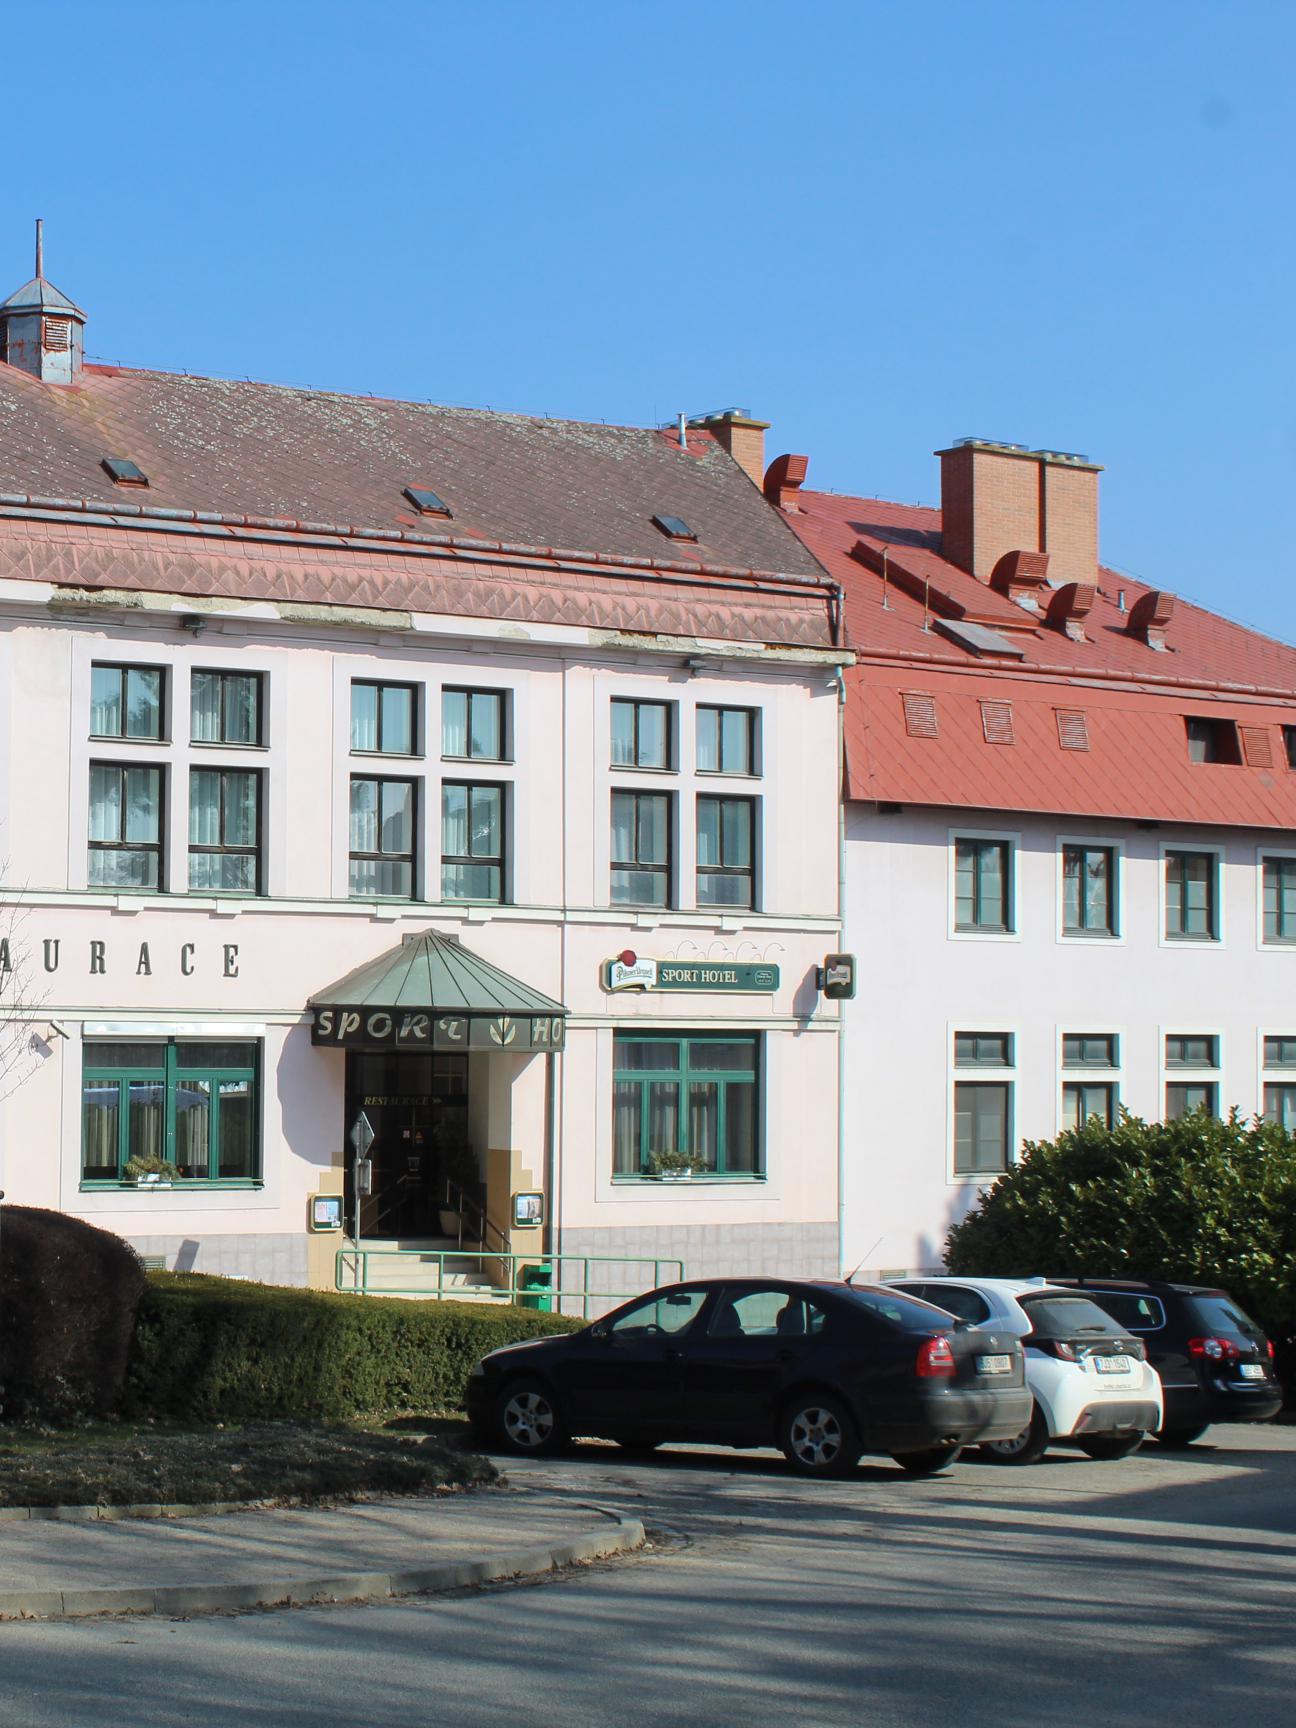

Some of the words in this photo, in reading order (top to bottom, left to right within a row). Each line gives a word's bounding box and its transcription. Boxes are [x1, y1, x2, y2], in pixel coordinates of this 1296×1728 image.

[661, 968, 698, 982] SPORT
[701, 969, 738, 983] HOTEL
[317, 1010, 466, 1040] SPORT
